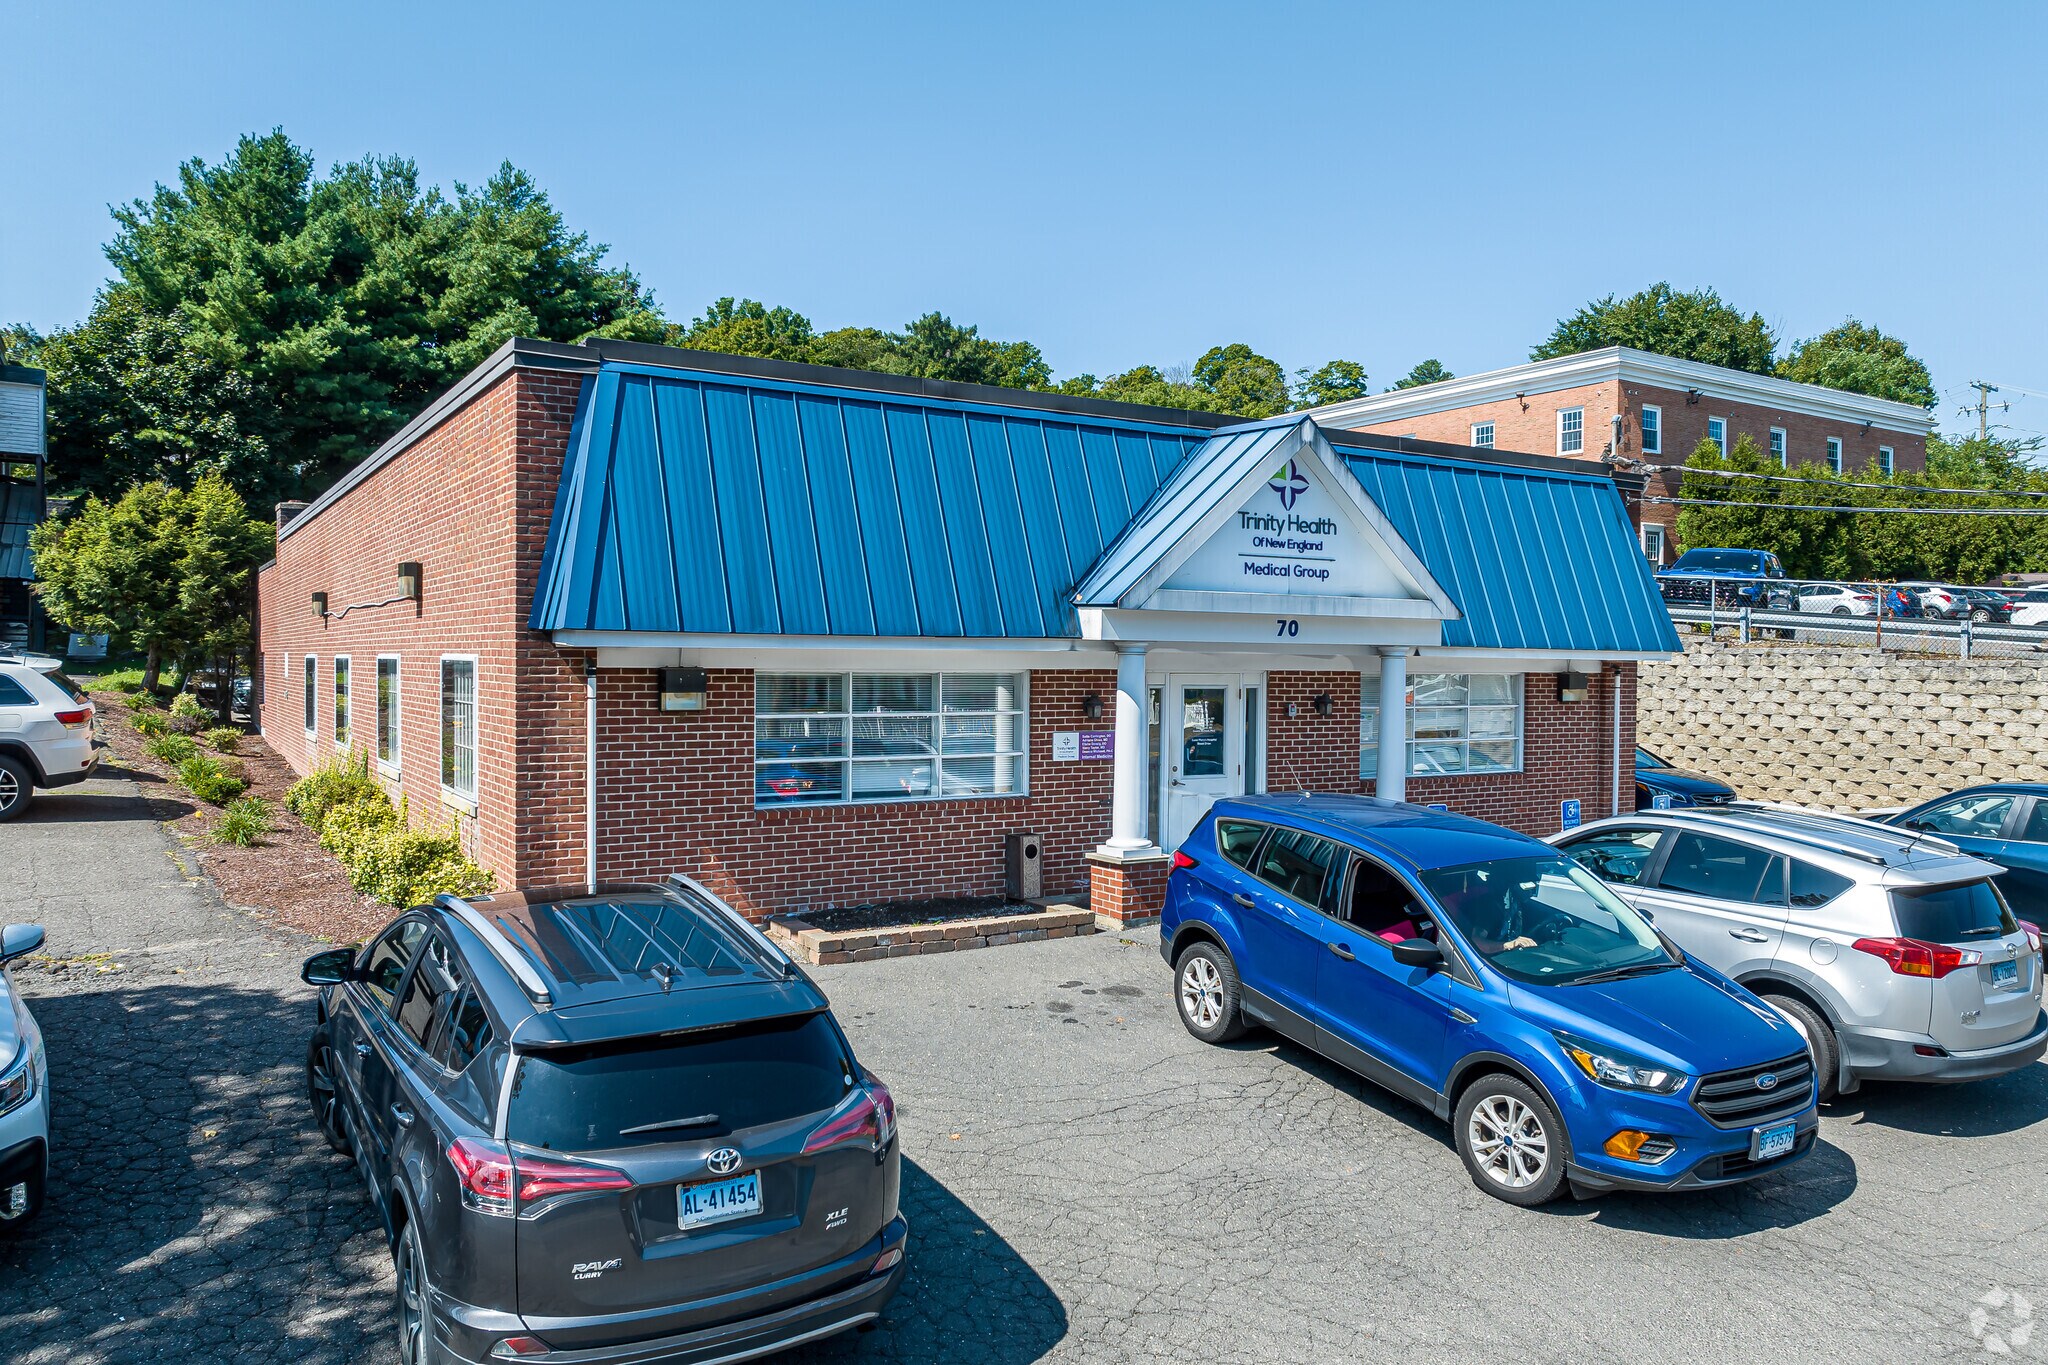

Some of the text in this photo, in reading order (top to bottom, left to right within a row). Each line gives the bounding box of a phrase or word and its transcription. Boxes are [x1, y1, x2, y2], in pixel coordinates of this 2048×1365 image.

[1238, 511, 1337, 536] Trinity Health
[1252, 536, 1323, 553] Of New England
[1244, 562, 1330, 582] Medical Group
[1276, 620, 1299, 637] 70
[1762, 1078, 1774, 1087] Ford
[700, 1179, 738, 1190] Connecticut
[826, 1207, 848, 1221] XLE
[826, 1218, 847, 1230] AWD
[572, 1258, 622, 1273] RAV4
[574, 1271, 602, 1280] CURRY
